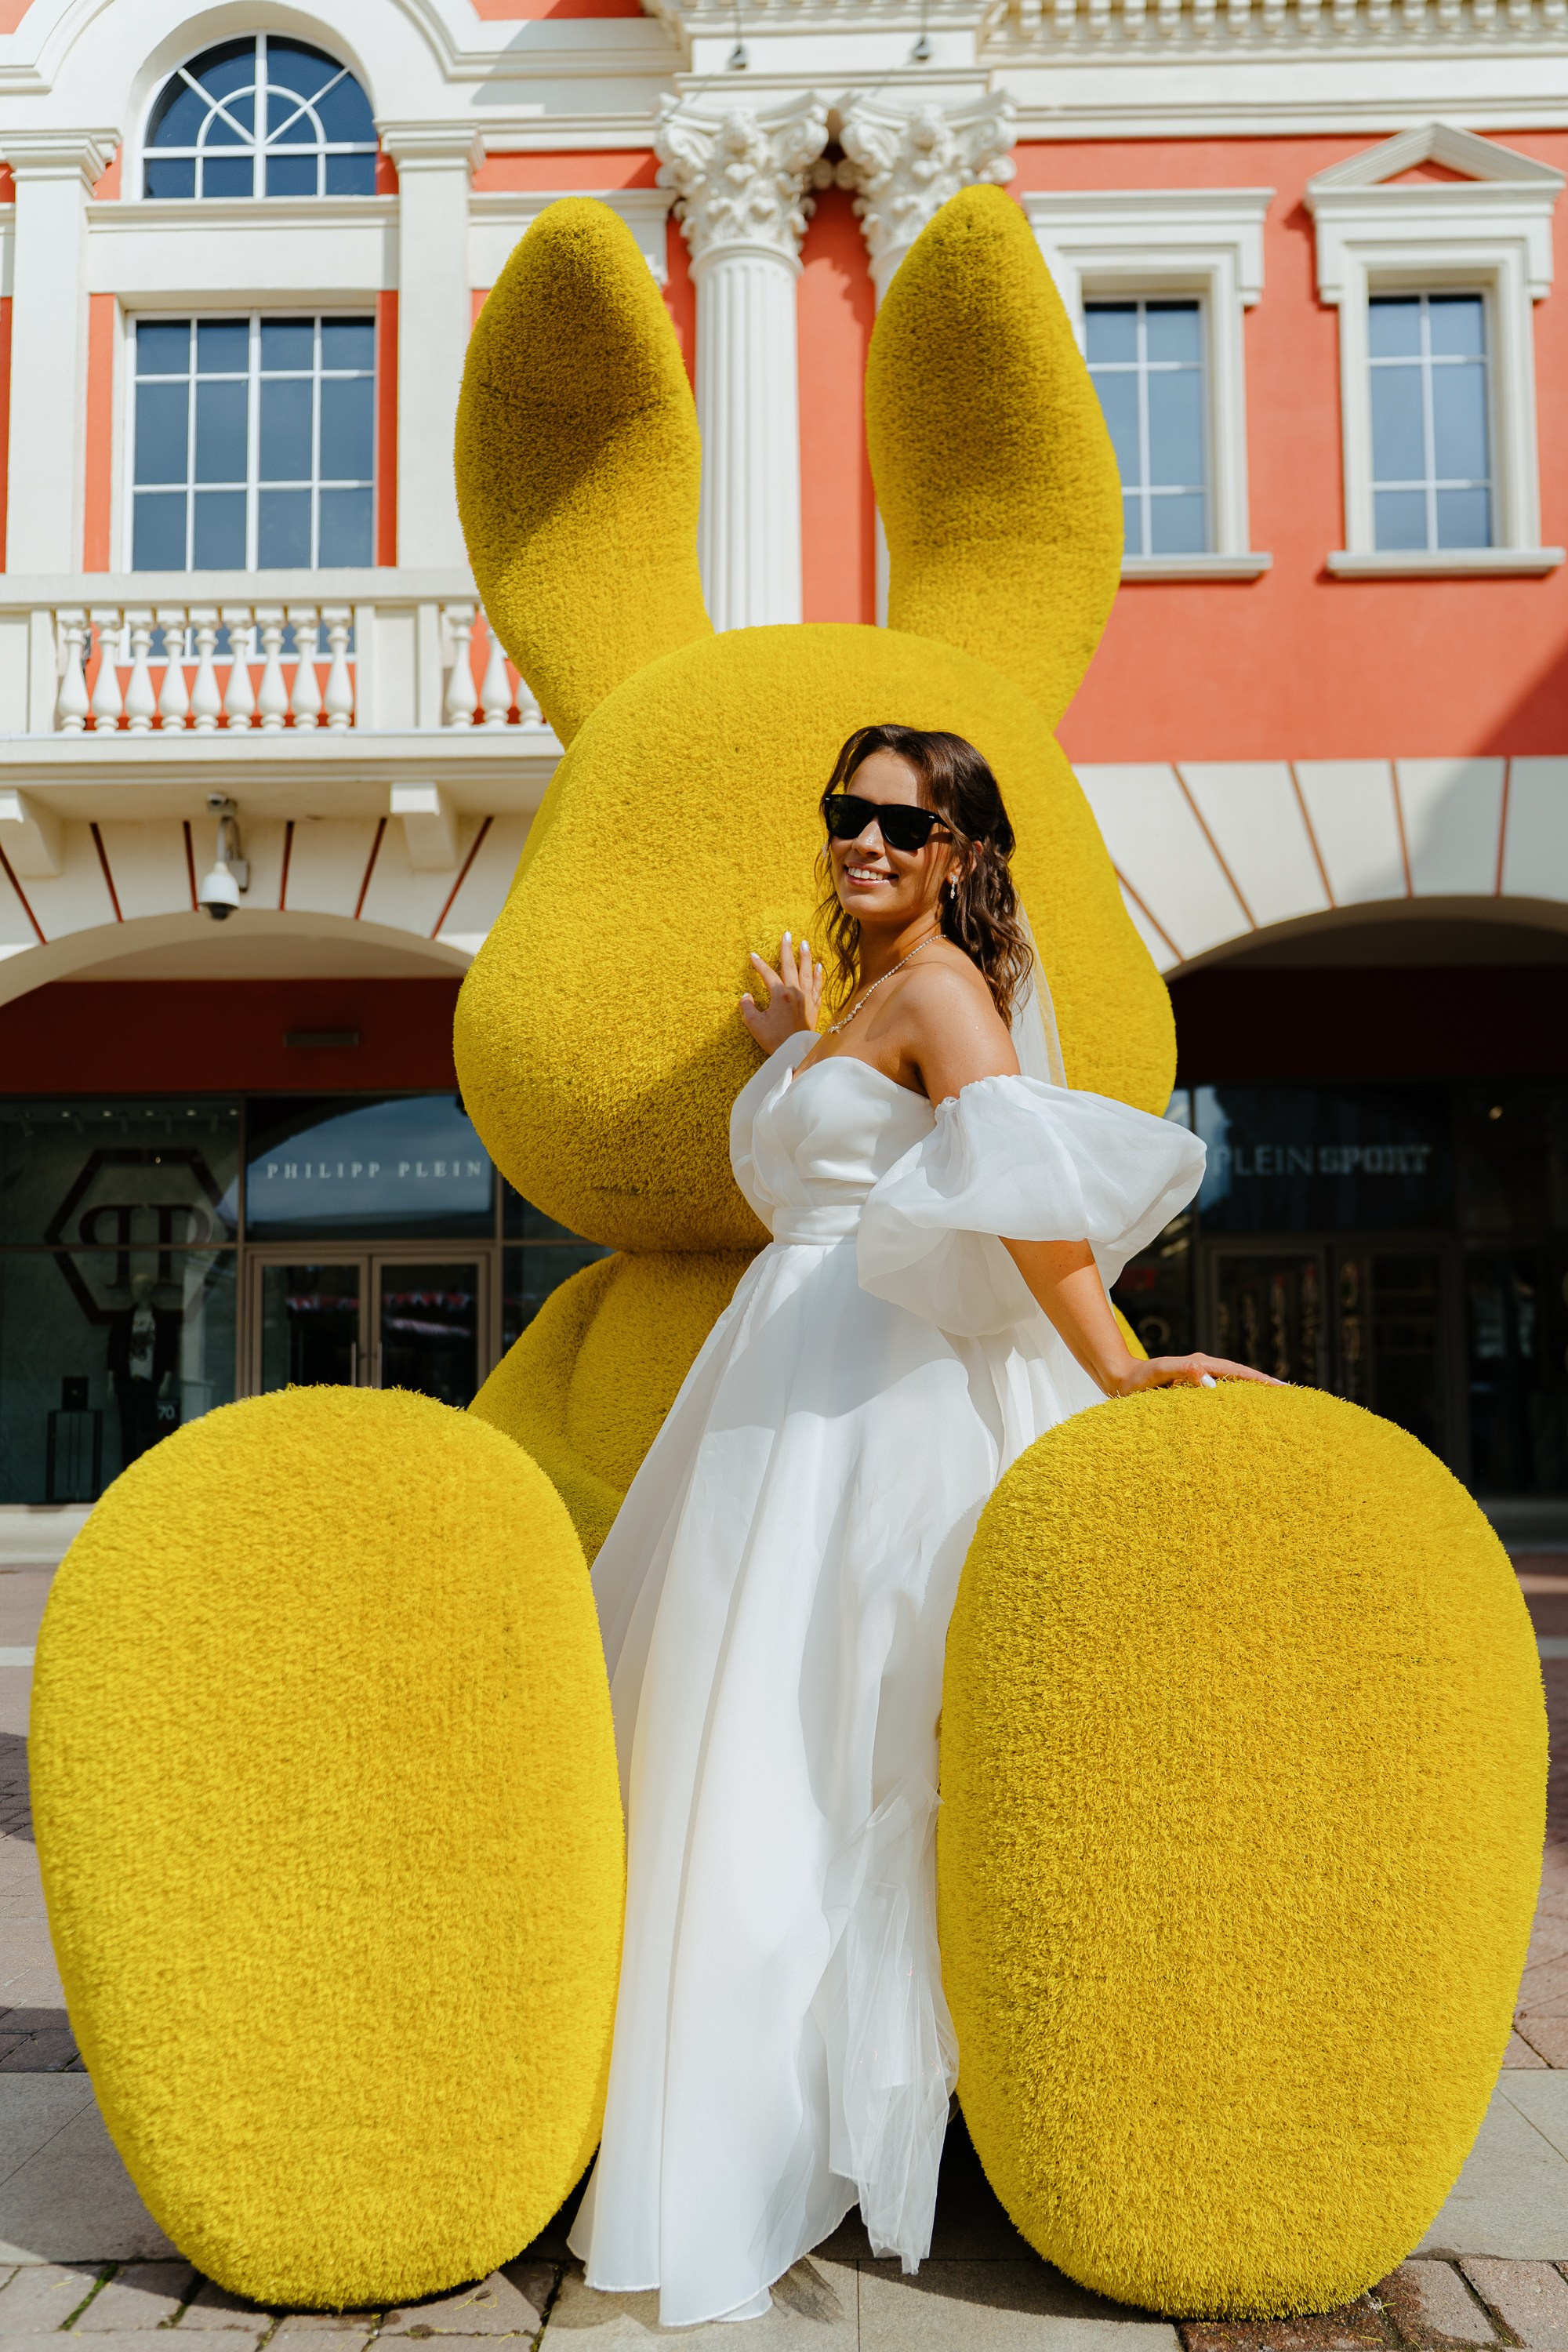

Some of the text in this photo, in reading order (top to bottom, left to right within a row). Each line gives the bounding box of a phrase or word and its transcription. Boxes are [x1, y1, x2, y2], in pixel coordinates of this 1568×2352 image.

[267, 1160, 481, 1179] PHILIPP PLEIN
[1214, 1145, 1431, 1175] PLEIN SPORT
